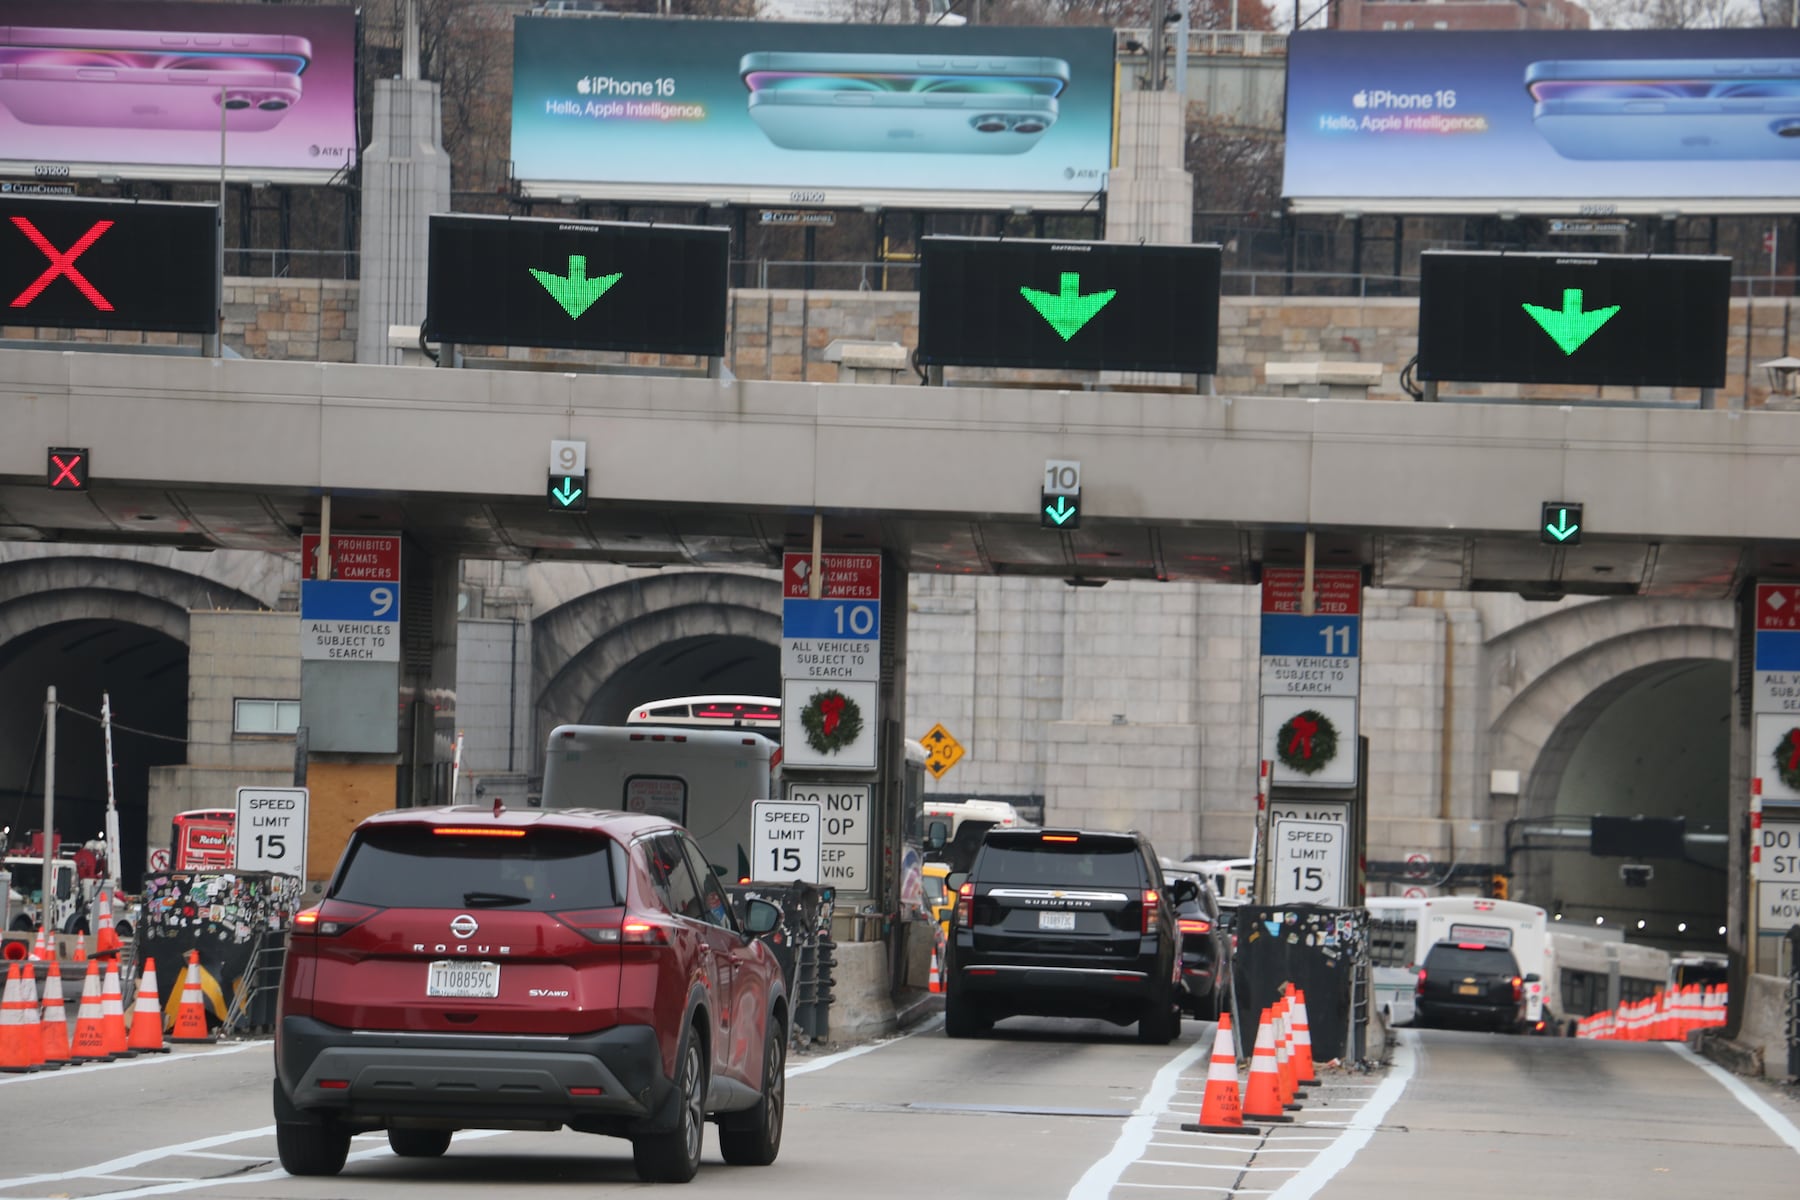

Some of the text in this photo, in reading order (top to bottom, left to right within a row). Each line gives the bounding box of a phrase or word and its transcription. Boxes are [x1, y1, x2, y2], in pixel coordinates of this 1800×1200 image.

[592, 77, 676, 95] iPhone 16
[1368, 90, 1457, 108] iPhone 16
[545, 100, 706, 119] Hello, Apple Intelligence.
[1319, 115, 1489, 132] Hello, Apple Intelligence.
[322, 147, 344, 157] AT&T
[1077, 169, 1099, 178] AT&T
[559, 447, 577, 470] 9
[1047, 466, 1078, 490] 10
[337, 540, 392, 551] PROHIBITED
[344, 567, 392, 578] CAMPERS
[369, 587, 393, 617] 9
[834, 605, 874, 635] 10
[312, 623, 391, 635] ALL VEHICLES
[317, 636, 385, 648] SUBJECT TO
[1319, 625, 1350, 655] 11
[329, 648, 373, 659] SEARCH
[792, 642, 870, 653] ALL VEHICLES
[797, 654, 865, 665] SUBJECT TO
[1270, 658, 1350, 669] ALL VEHICLES
[809, 666, 853, 677] SEARCH
[1275, 670, 1344, 681] SUBJECT TO
[1766, 674, 1786, 685] ALL
[1287, 682, 1332, 693] SEARCH
[250, 800, 295, 810] SPEED
[827, 793, 864, 812] NOT
[253, 816, 290, 827] LIMIT
[765, 812, 810, 823] SPEED
[768, 829, 805, 840] LIMIT
[1287, 830, 1333, 843] SPEED
[1763, 830, 1791, 848] DO
[255, 834, 286, 859] 15
[821, 849, 846, 861] EEP
[1290, 847, 1328, 859] LIMIT
[771, 847, 802, 872] 15
[822, 865, 855, 878] VING
[1293, 866, 1323, 891] 15
[1025, 899, 1091, 907] SUBURBAN
[413, 943, 511, 954] ROGUE
[435, 970, 492, 989] T108859C
